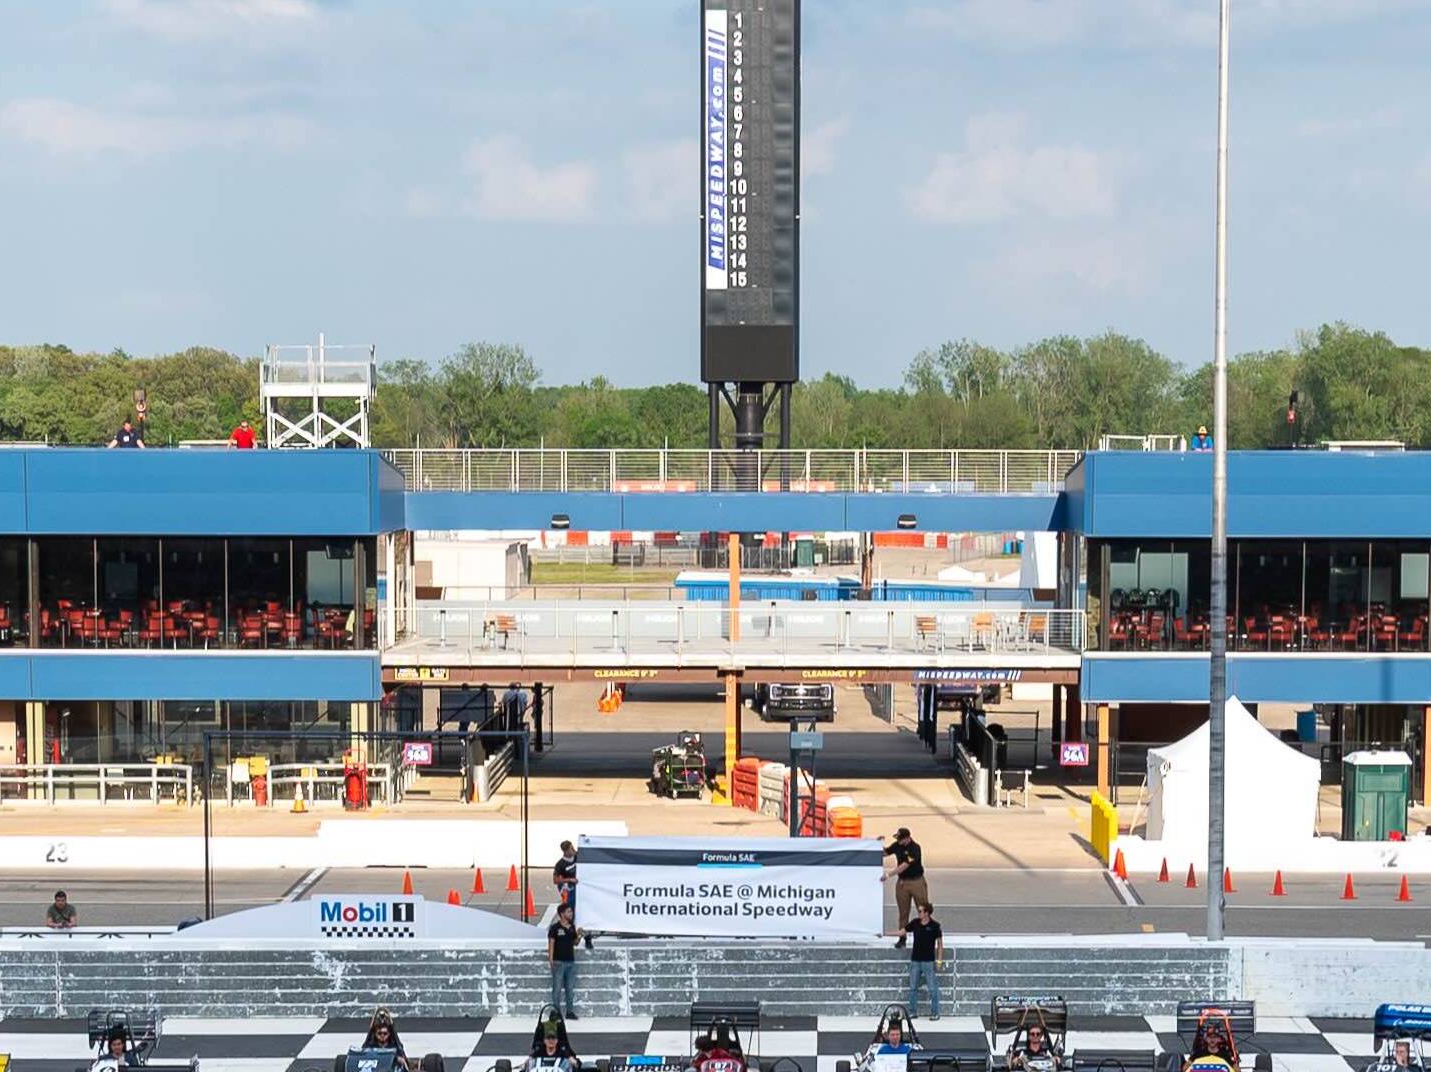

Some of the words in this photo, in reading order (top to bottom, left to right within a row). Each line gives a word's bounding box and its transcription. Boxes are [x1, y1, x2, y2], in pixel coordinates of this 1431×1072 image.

[734, 13, 743, 28] 1
[733, 31, 743, 47] 2
[733, 49, 743, 66] 3
[733, 68, 743, 84] 4
[733, 86, 743, 102] 5
[733, 105, 743, 121] 6
[733, 123, 743, 139] 7
[733, 142, 743, 158] 8
[710, 66, 724, 260] MISPEEDWAY.com
[733, 160, 743, 177] 9
[729, 179, 747, 195] 10
[730, 197, 746, 213] 11
[729, 215, 747, 232] 12
[729, 234, 747, 250] 13
[729, 252, 747, 269] 14
[729, 271, 747, 287] 15
[594, 669, 639, 678] CLEARANCE
[802, 670, 847, 679] CLEARANCE
[918, 669, 1007, 680] MISPEEDWAY.com
[702, 853, 737, 862] Formula
[738, 853, 755, 862] SAE
[623, 883, 695, 899] Formula
[698, 884, 732, 899] SAE
[737, 884, 754, 900] @
[757, 884, 836, 902] Michigan
[320, 902, 387, 922] Mobil
[625, 901, 739, 917] International
[742, 903, 834, 920] Speedway
